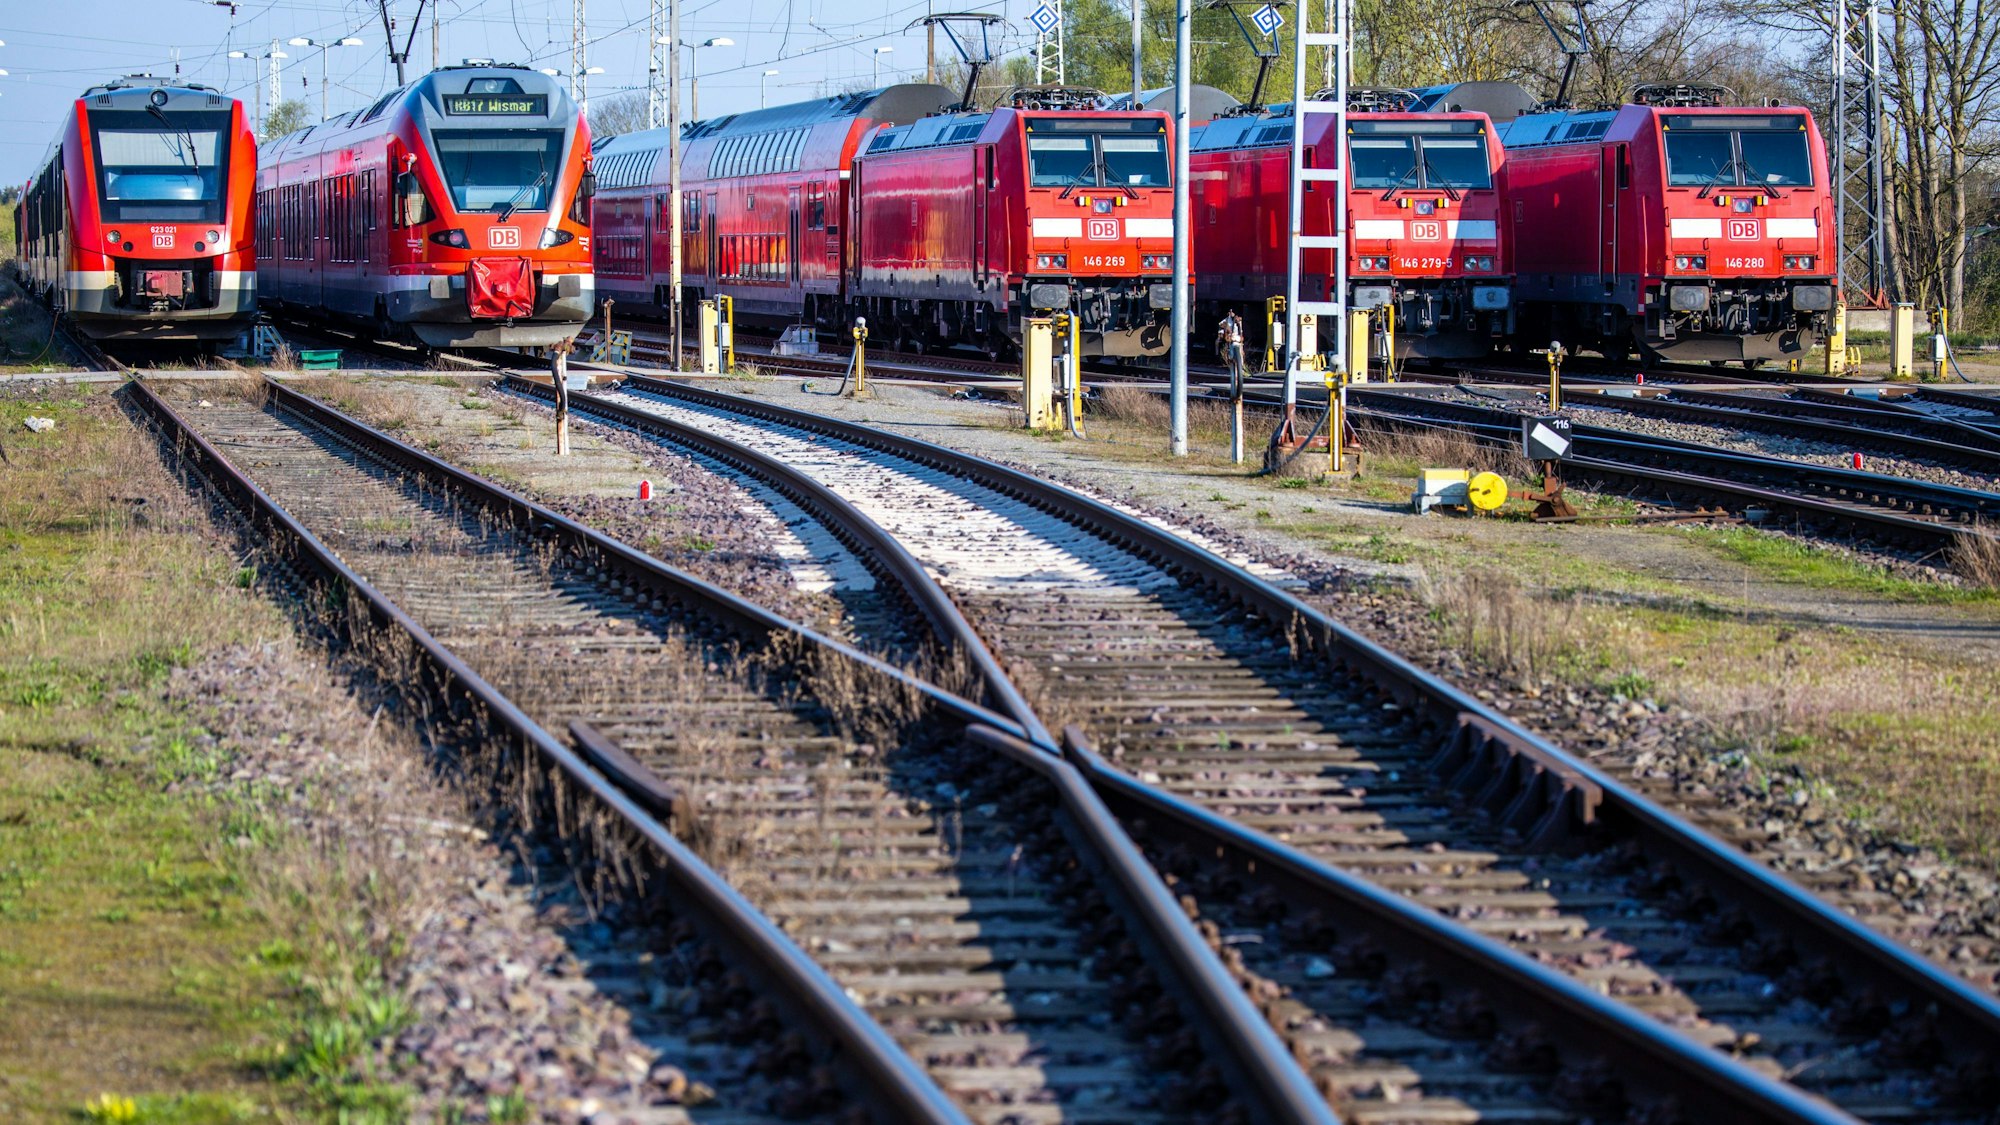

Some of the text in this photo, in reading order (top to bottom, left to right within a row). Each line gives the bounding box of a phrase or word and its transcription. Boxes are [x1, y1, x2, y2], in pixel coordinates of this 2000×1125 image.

[454, 99, 534, 112] RB17 Wismar
[150, 225, 177, 234] 623 021
[1091, 221, 1117, 238] DB
[1413, 223, 1438, 239] DB
[1731, 221, 1757, 238] DB
[155, 236, 173, 247] DB
[491, 229, 518, 246] DB
[1083, 255, 1126, 267] 146 269
[1400, 257, 1453, 269] 146 279-5
[1725, 257, 1765, 269] 146 280
[1552, 419, 1569, 430] 116
